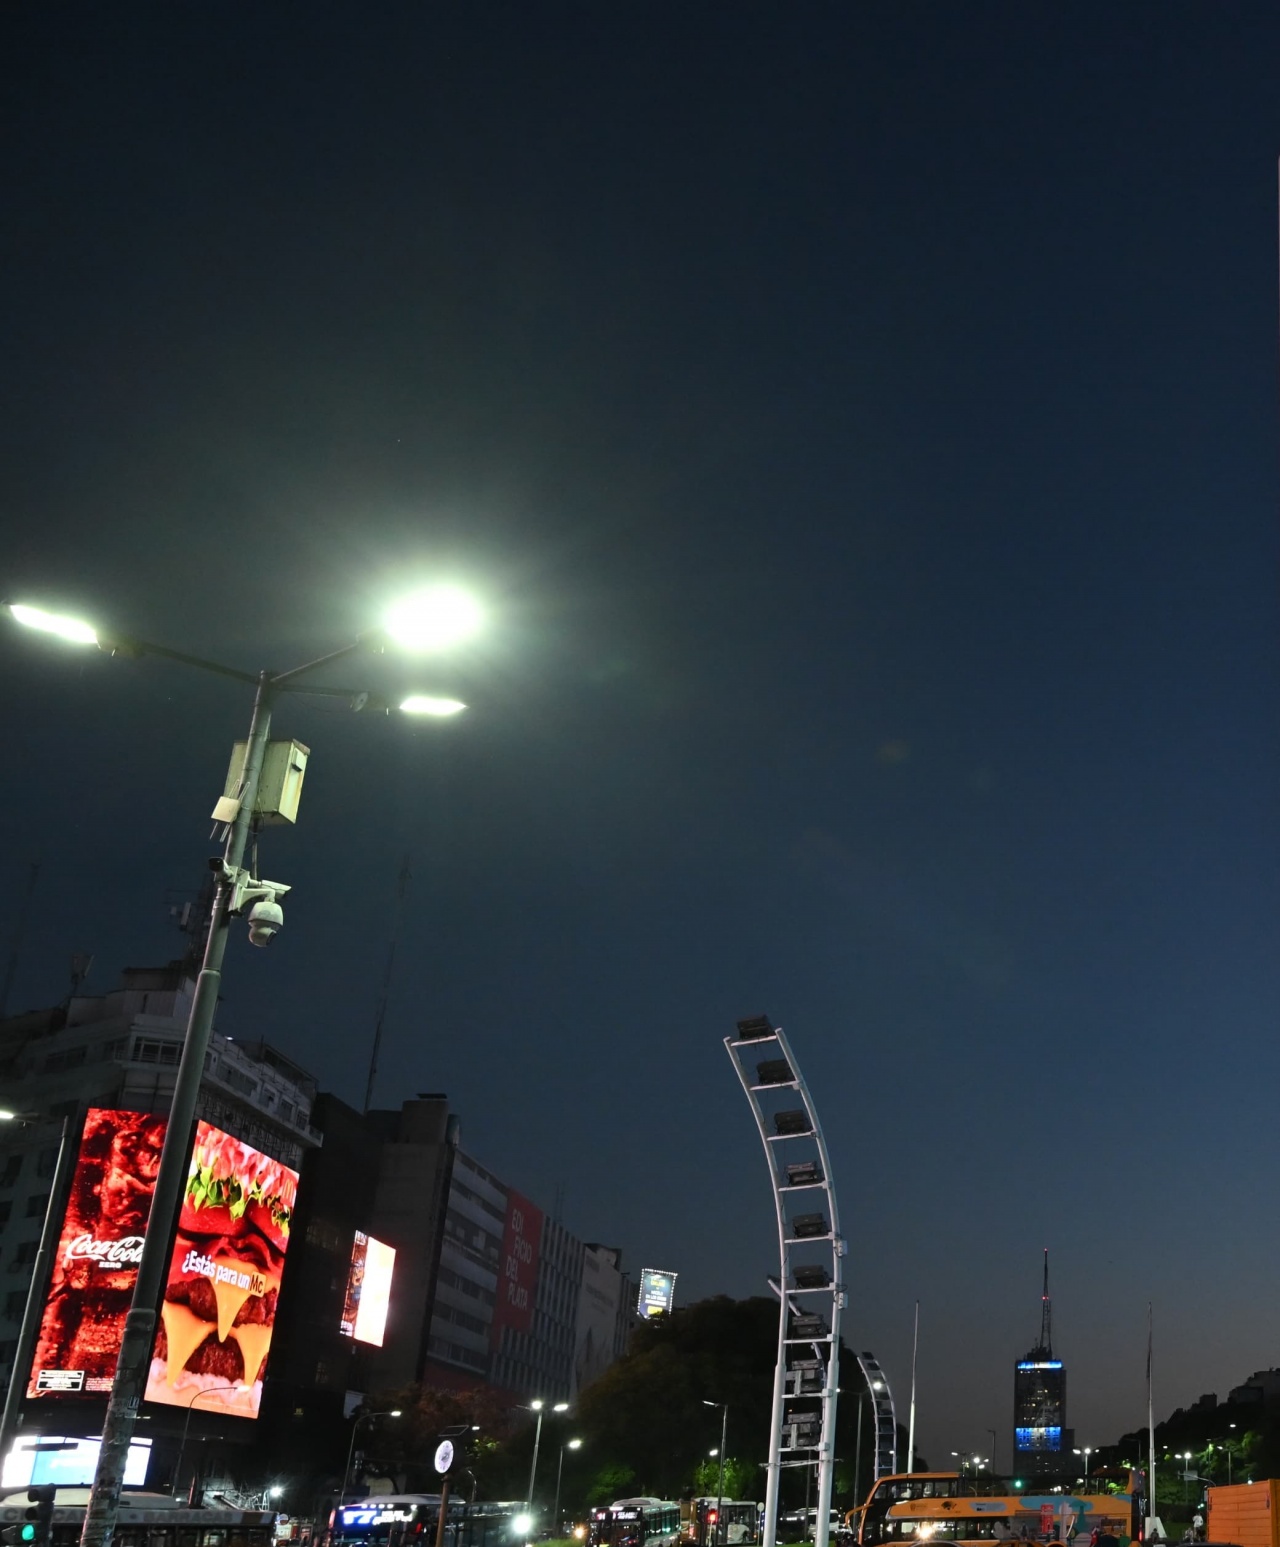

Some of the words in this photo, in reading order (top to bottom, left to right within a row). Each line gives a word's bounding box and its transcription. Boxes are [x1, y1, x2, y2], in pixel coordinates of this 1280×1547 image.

[182, 1250, 216, 1277] ¿Estás
[215, 1265, 238, 1285] para
[237, 1272, 251, 1290] un
[250, 1274, 264, 1293] Mc
[506, 1255, 518, 1282] DEL
